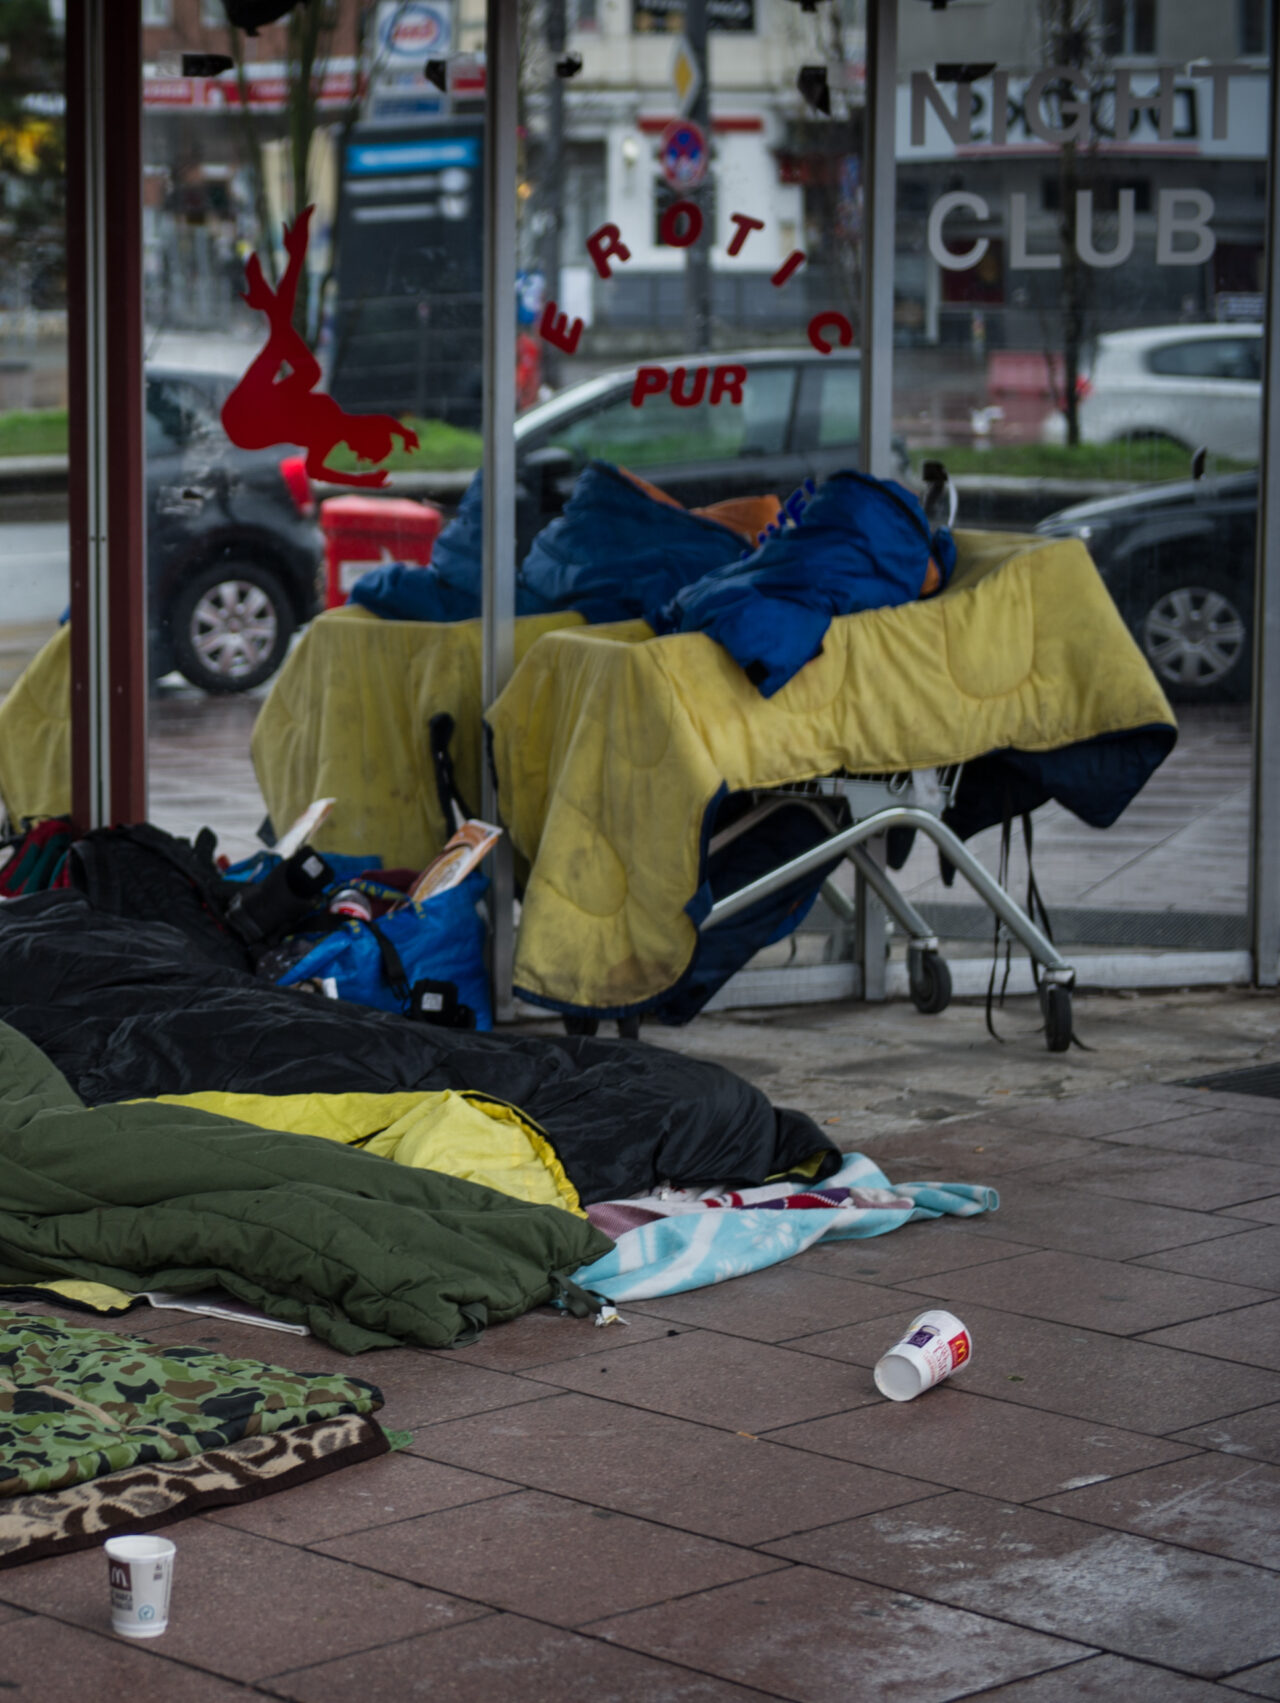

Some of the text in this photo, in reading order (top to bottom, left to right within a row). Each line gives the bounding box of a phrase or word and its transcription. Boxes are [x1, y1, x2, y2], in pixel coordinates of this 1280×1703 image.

[910, 65, 1251, 146] NIGHT
[927, 188, 1217, 271] CLUB
[540, 202, 854, 355] EROTIC
[631, 365, 747, 408] PUR
